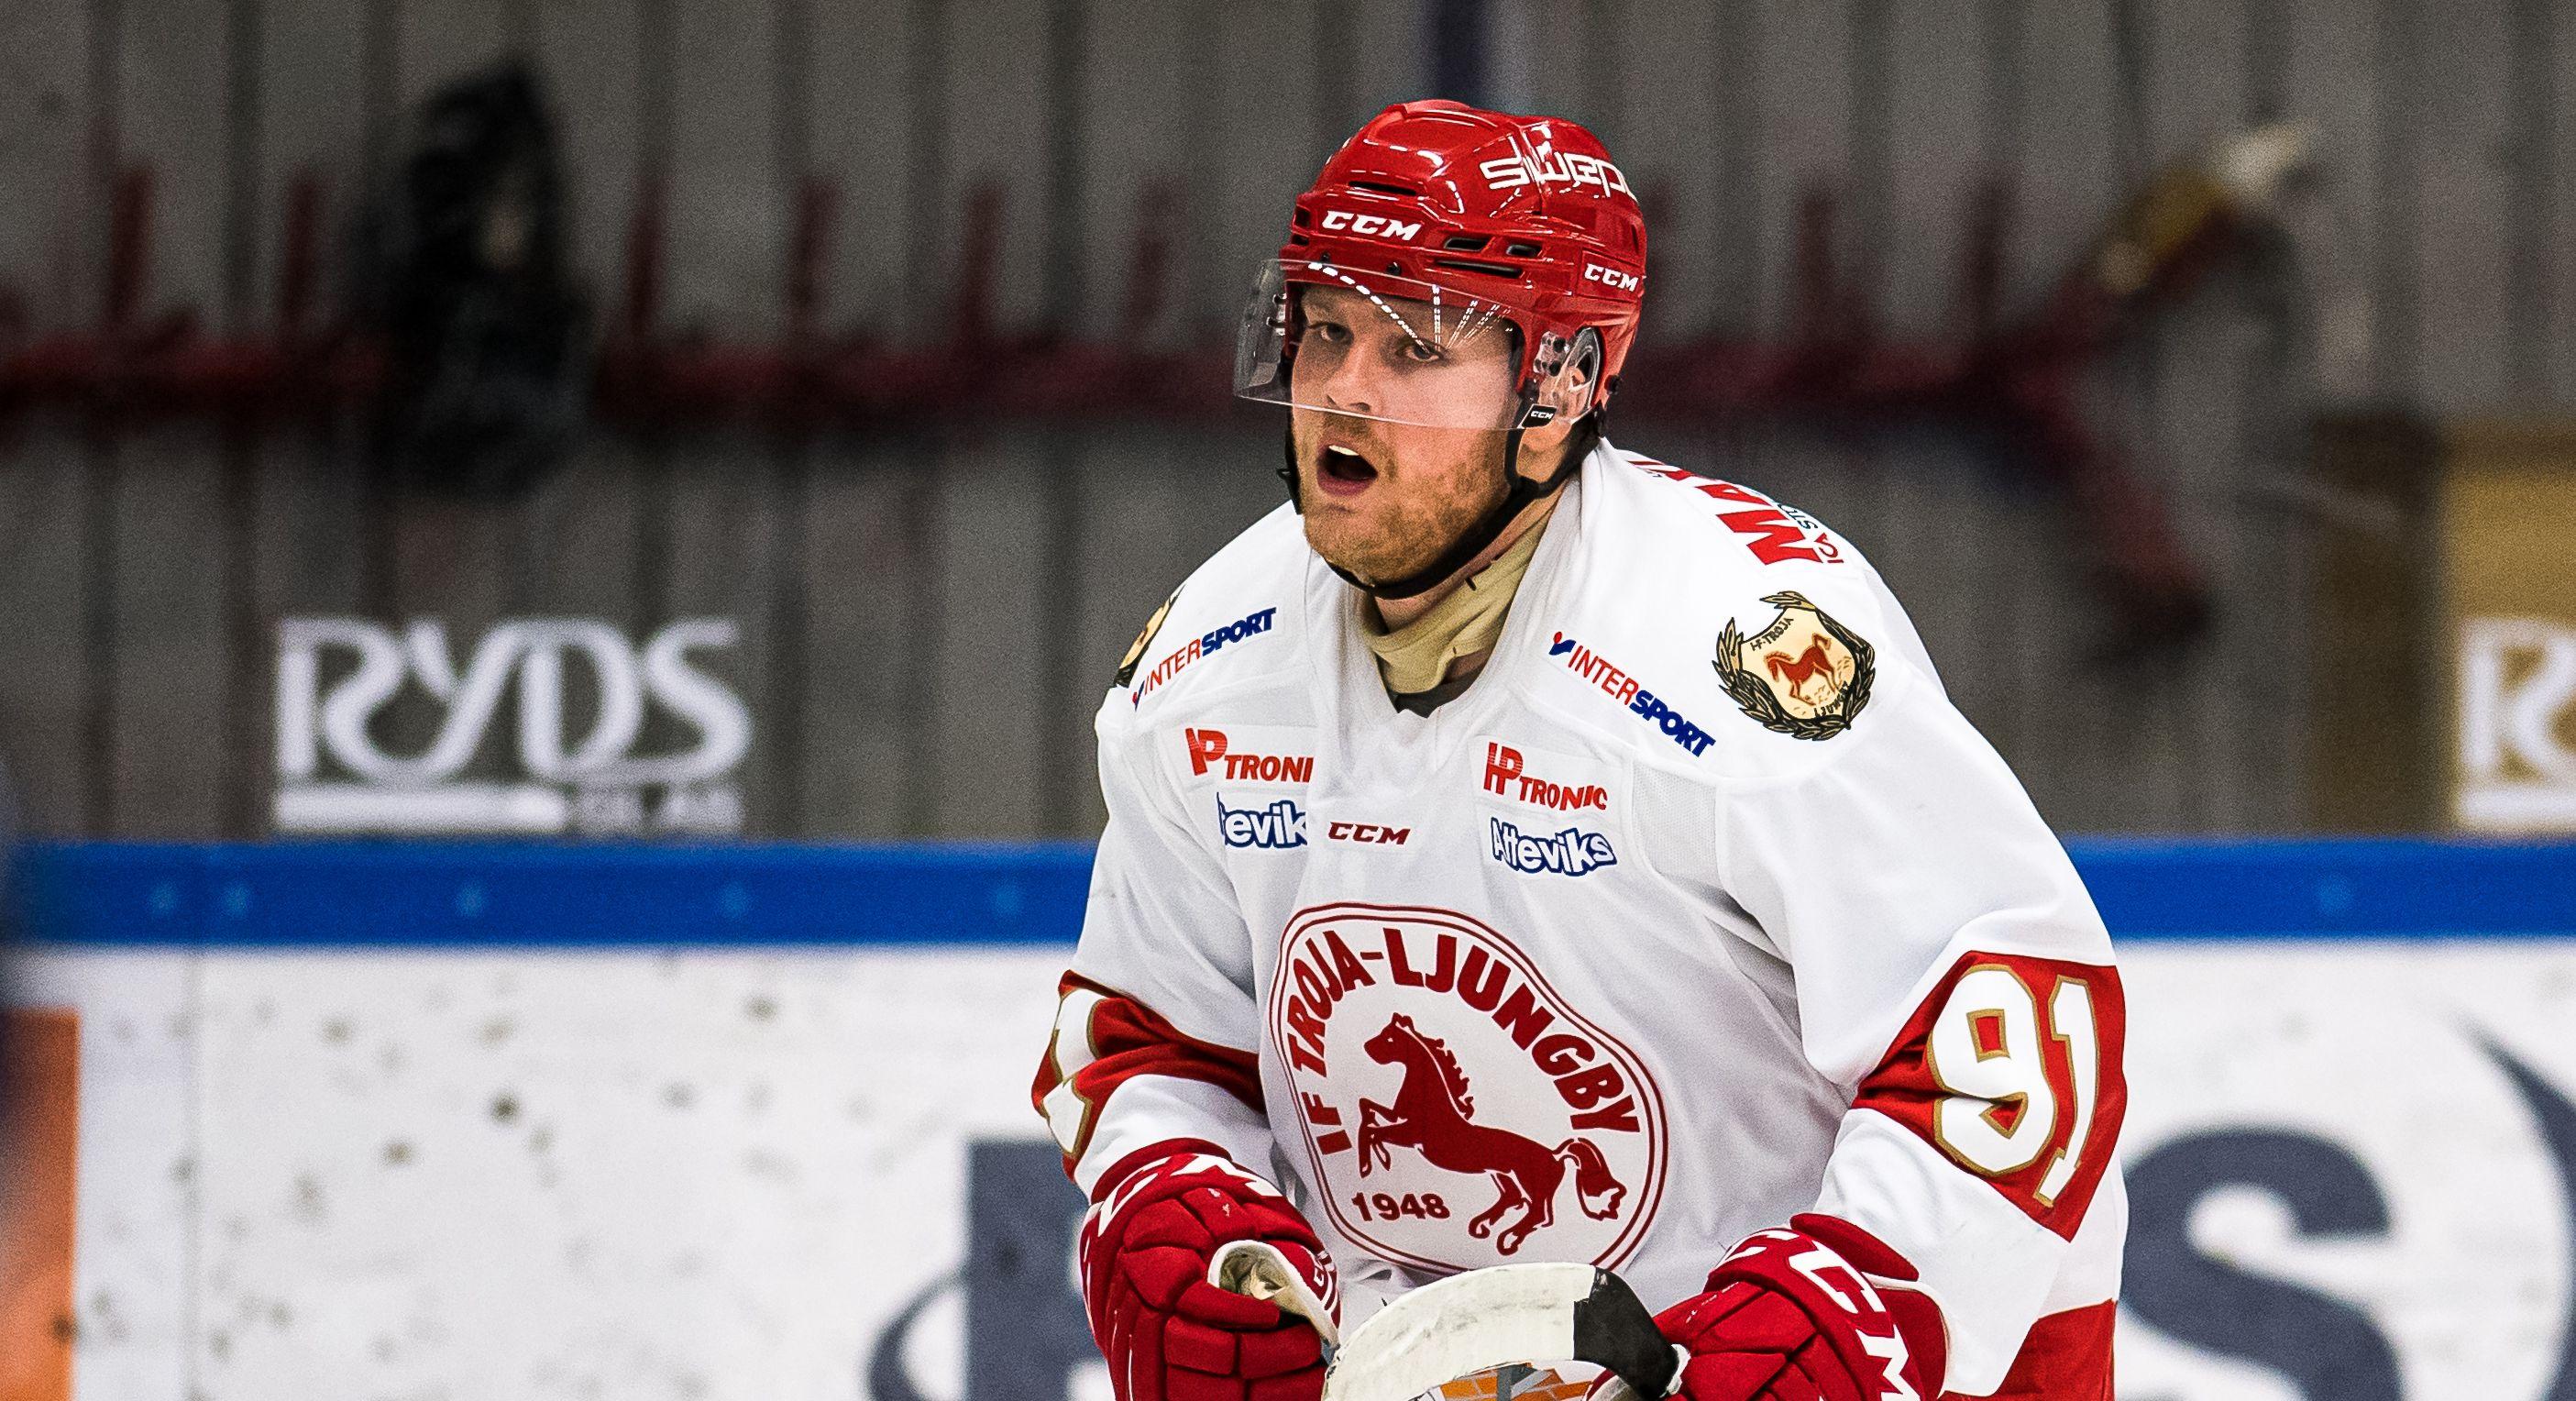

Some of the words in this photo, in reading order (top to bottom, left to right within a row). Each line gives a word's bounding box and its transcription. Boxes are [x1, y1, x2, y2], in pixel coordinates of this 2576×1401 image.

[1320, 210, 1423, 241] CCM
[1583, 263, 1639, 292] CCM
[1530, 410, 1554, 420] CCM
[1144, 607, 1276, 696] INTERSPORT
[277, 619, 754, 781] RYDS
[1568, 645, 1716, 757] INTERSPORT
[1225, 755, 1314, 783] TRONI
[1328, 822, 1411, 845] CCM
[1491, 817, 1618, 877] Atteviks
[1286, 927, 1641, 1133] TROJA-LJUNGBY
[1927, 964, 2100, 1208] 91
[1301, 1091, 1352, 1155] IF
[1351, 1192, 1450, 1221] 1948
